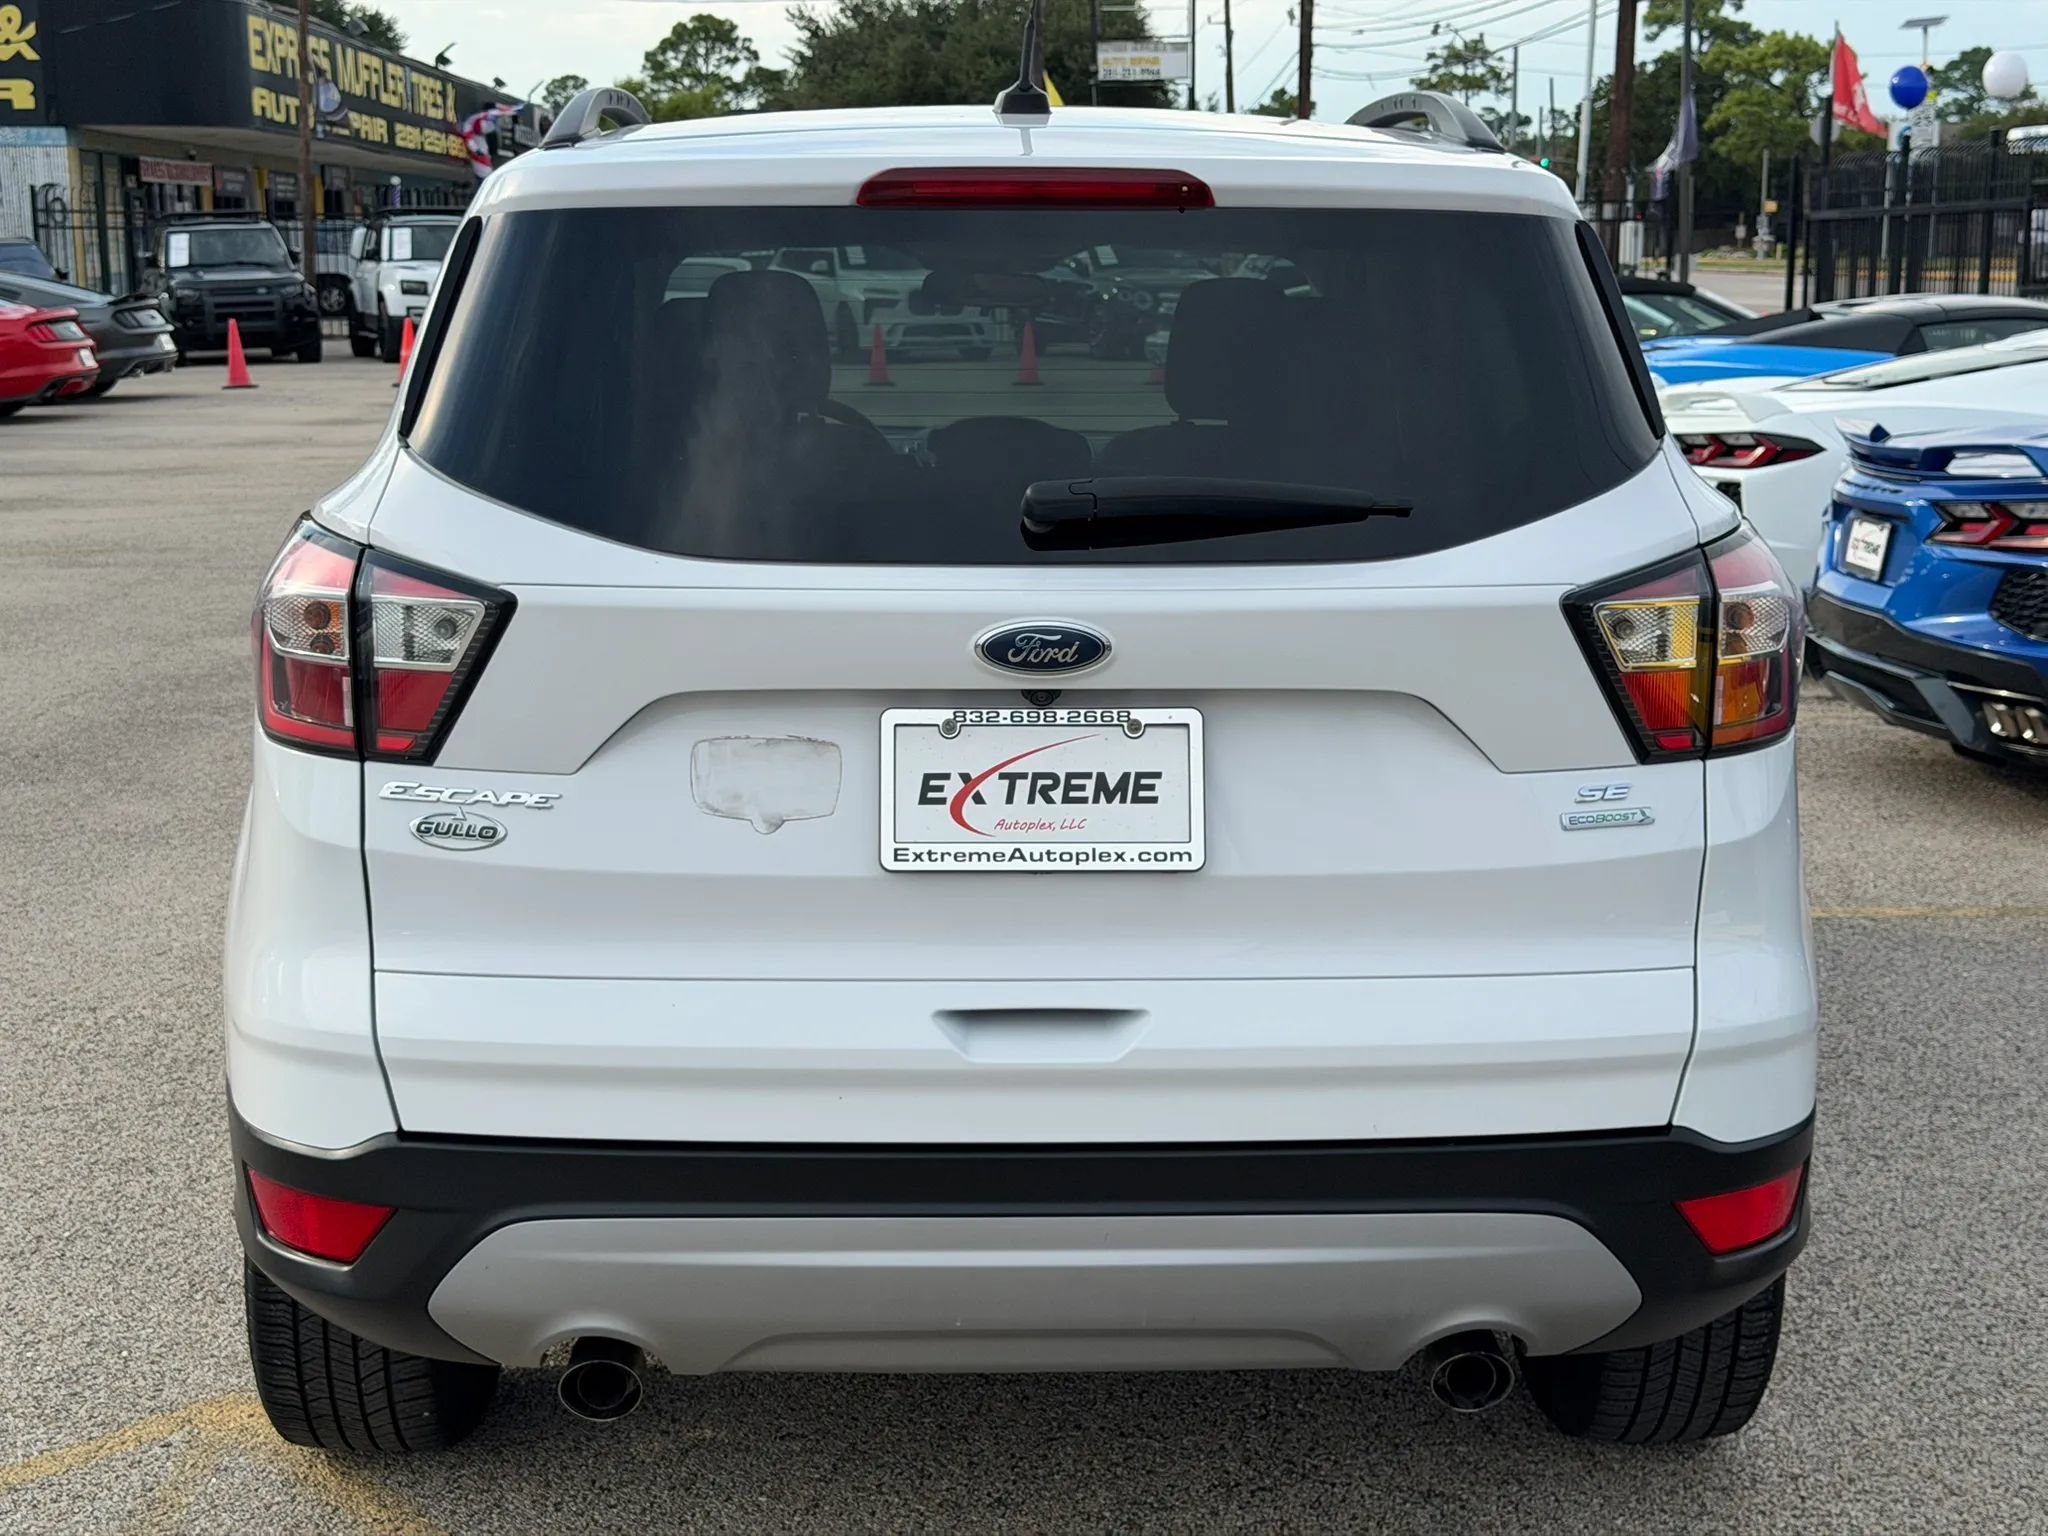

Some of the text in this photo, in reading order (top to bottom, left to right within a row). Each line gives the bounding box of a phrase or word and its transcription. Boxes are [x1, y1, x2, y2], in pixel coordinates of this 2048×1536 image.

[247, 14, 333, 83] EXPRSS
[335, 43, 408, 111] MUFFLER
[410, 71, 444, 120] TIRES
[1007, 632, 1080, 664] Ford
[952, 710, 1132, 724] 832-698-2668
[379, 780, 562, 810] ESCAPE
[918, 771, 1163, 806] EXTREME
[1574, 782, 1633, 804] SE
[416, 821, 499, 841] GULLO
[994, 818, 1088, 833] Autoplex, LLC
[893, 848, 1193, 866] ExtremeAutoplex.com
